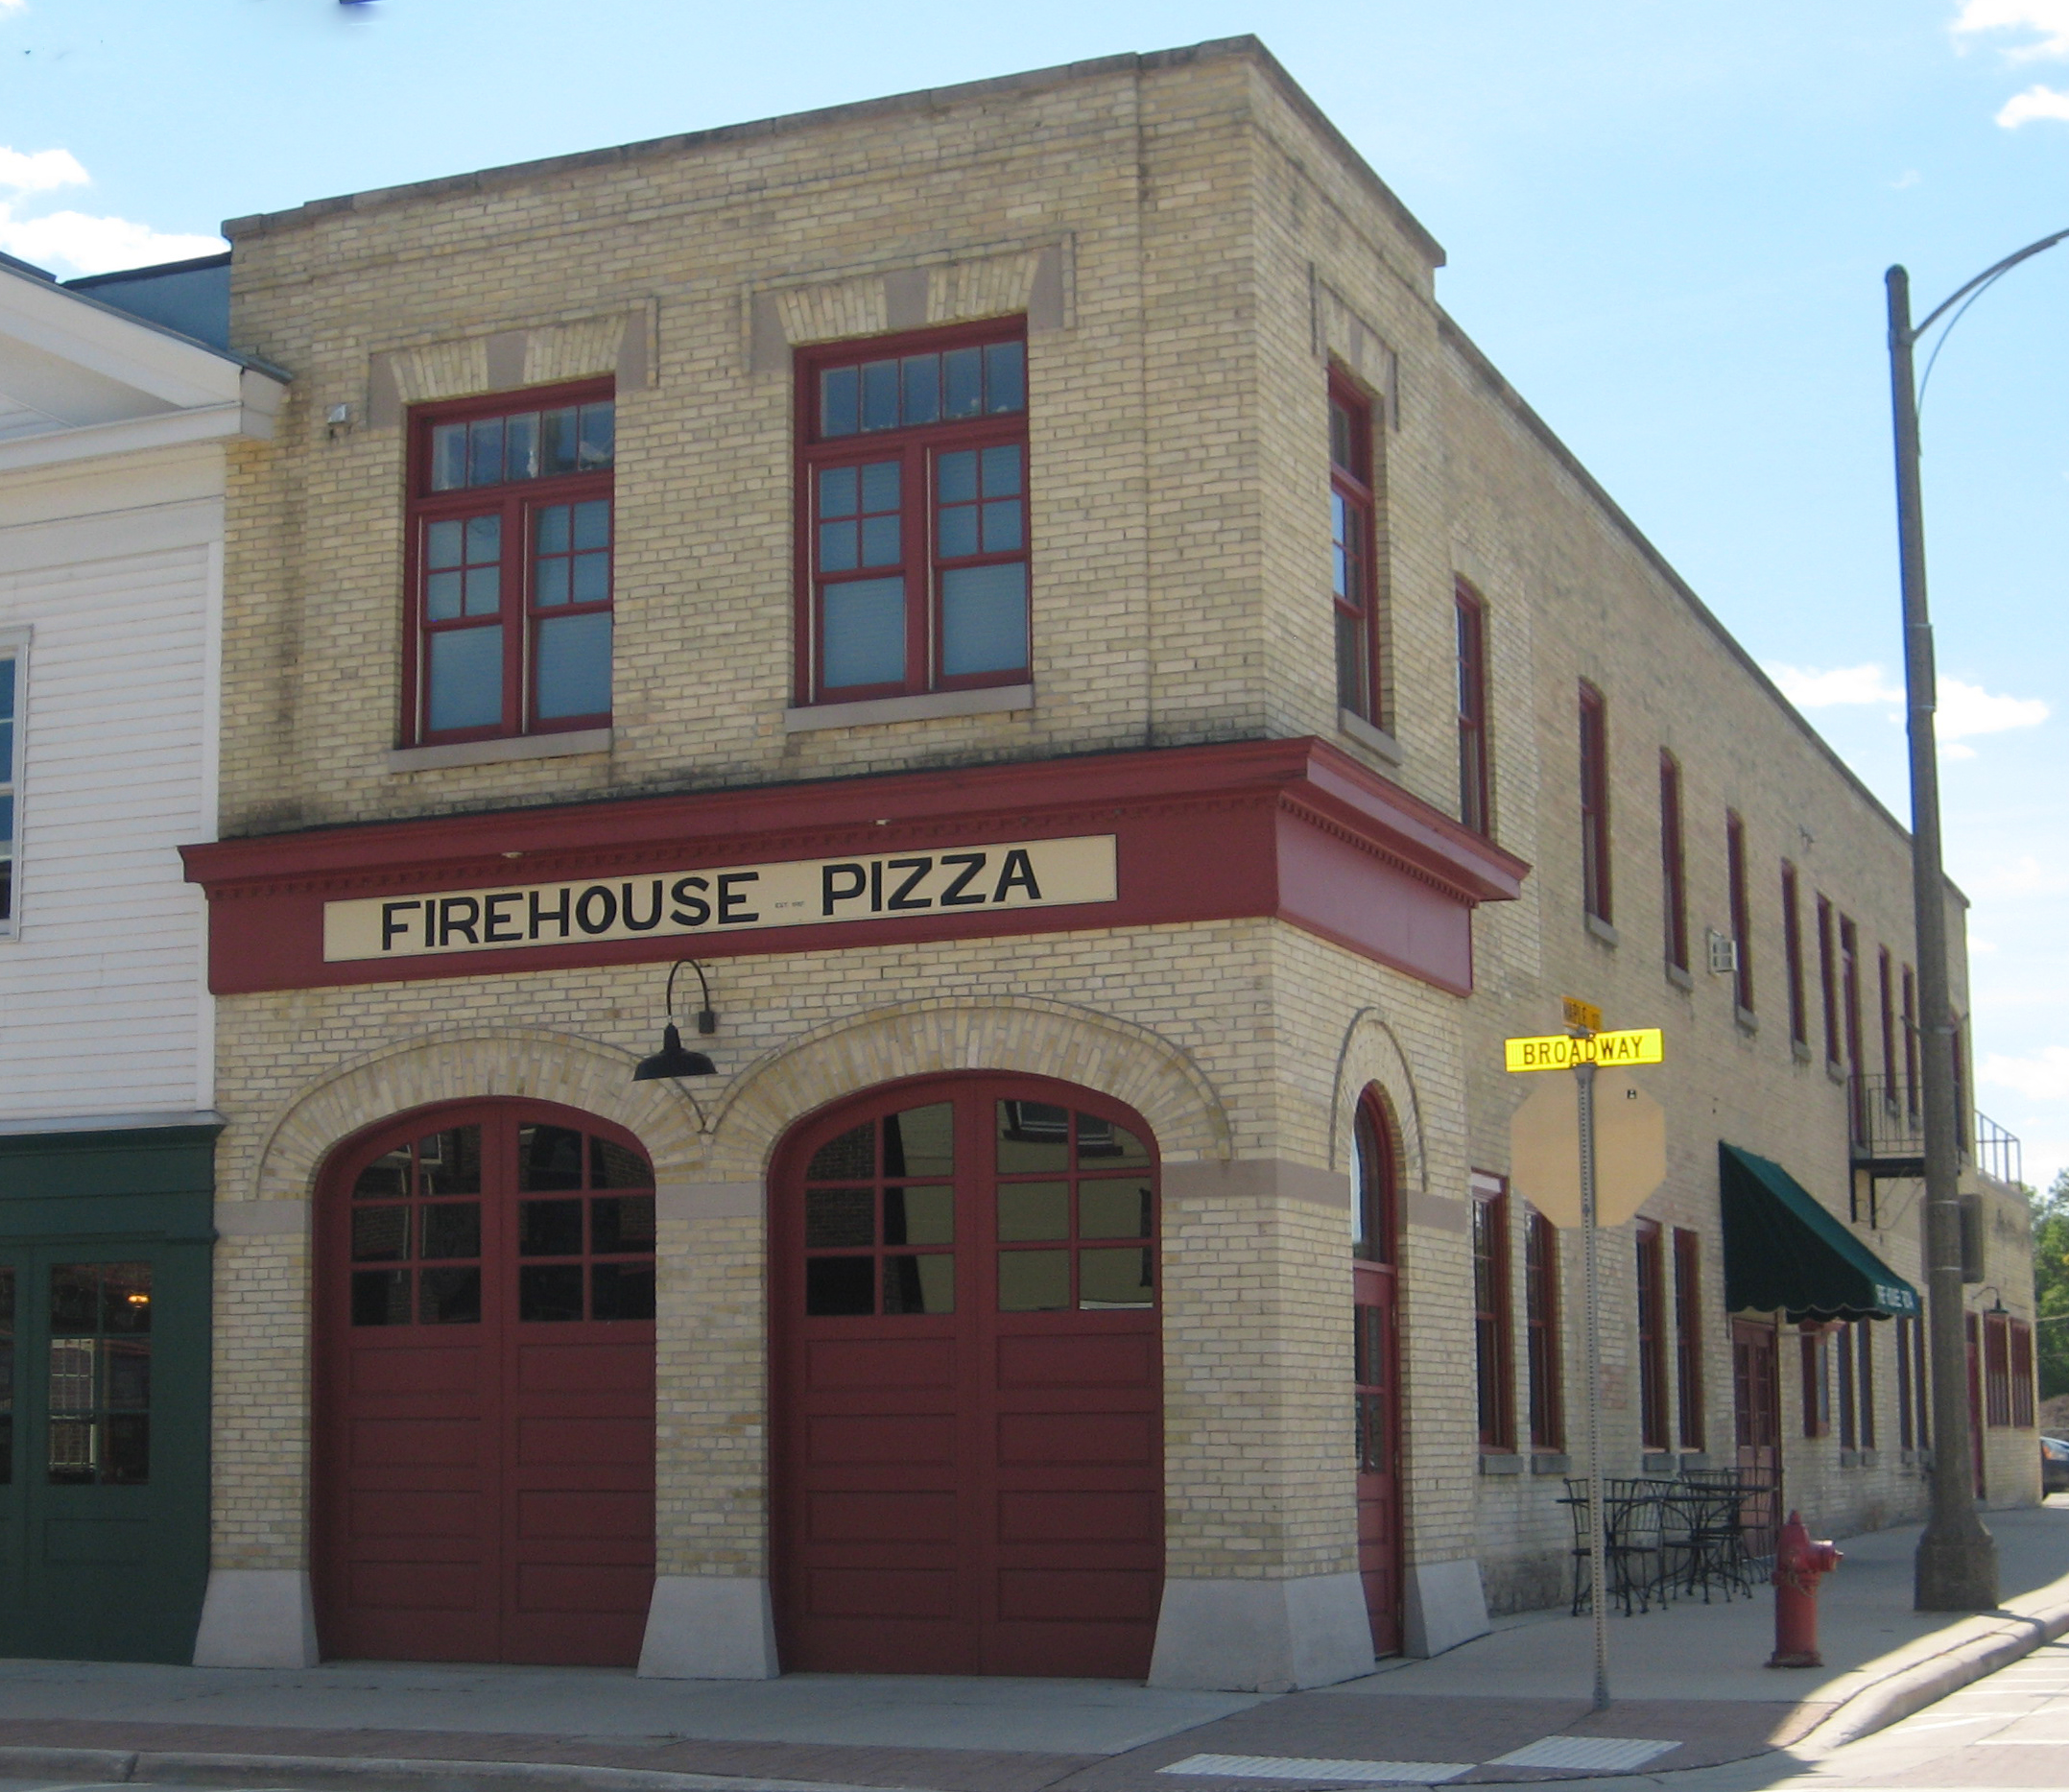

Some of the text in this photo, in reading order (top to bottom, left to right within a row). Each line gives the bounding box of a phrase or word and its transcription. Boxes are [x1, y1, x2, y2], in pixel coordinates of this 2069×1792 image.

[382, 848, 1041, 951] FIREHOUSE PIZZA
[1523, 1037, 1643, 1064] BROADWAY
